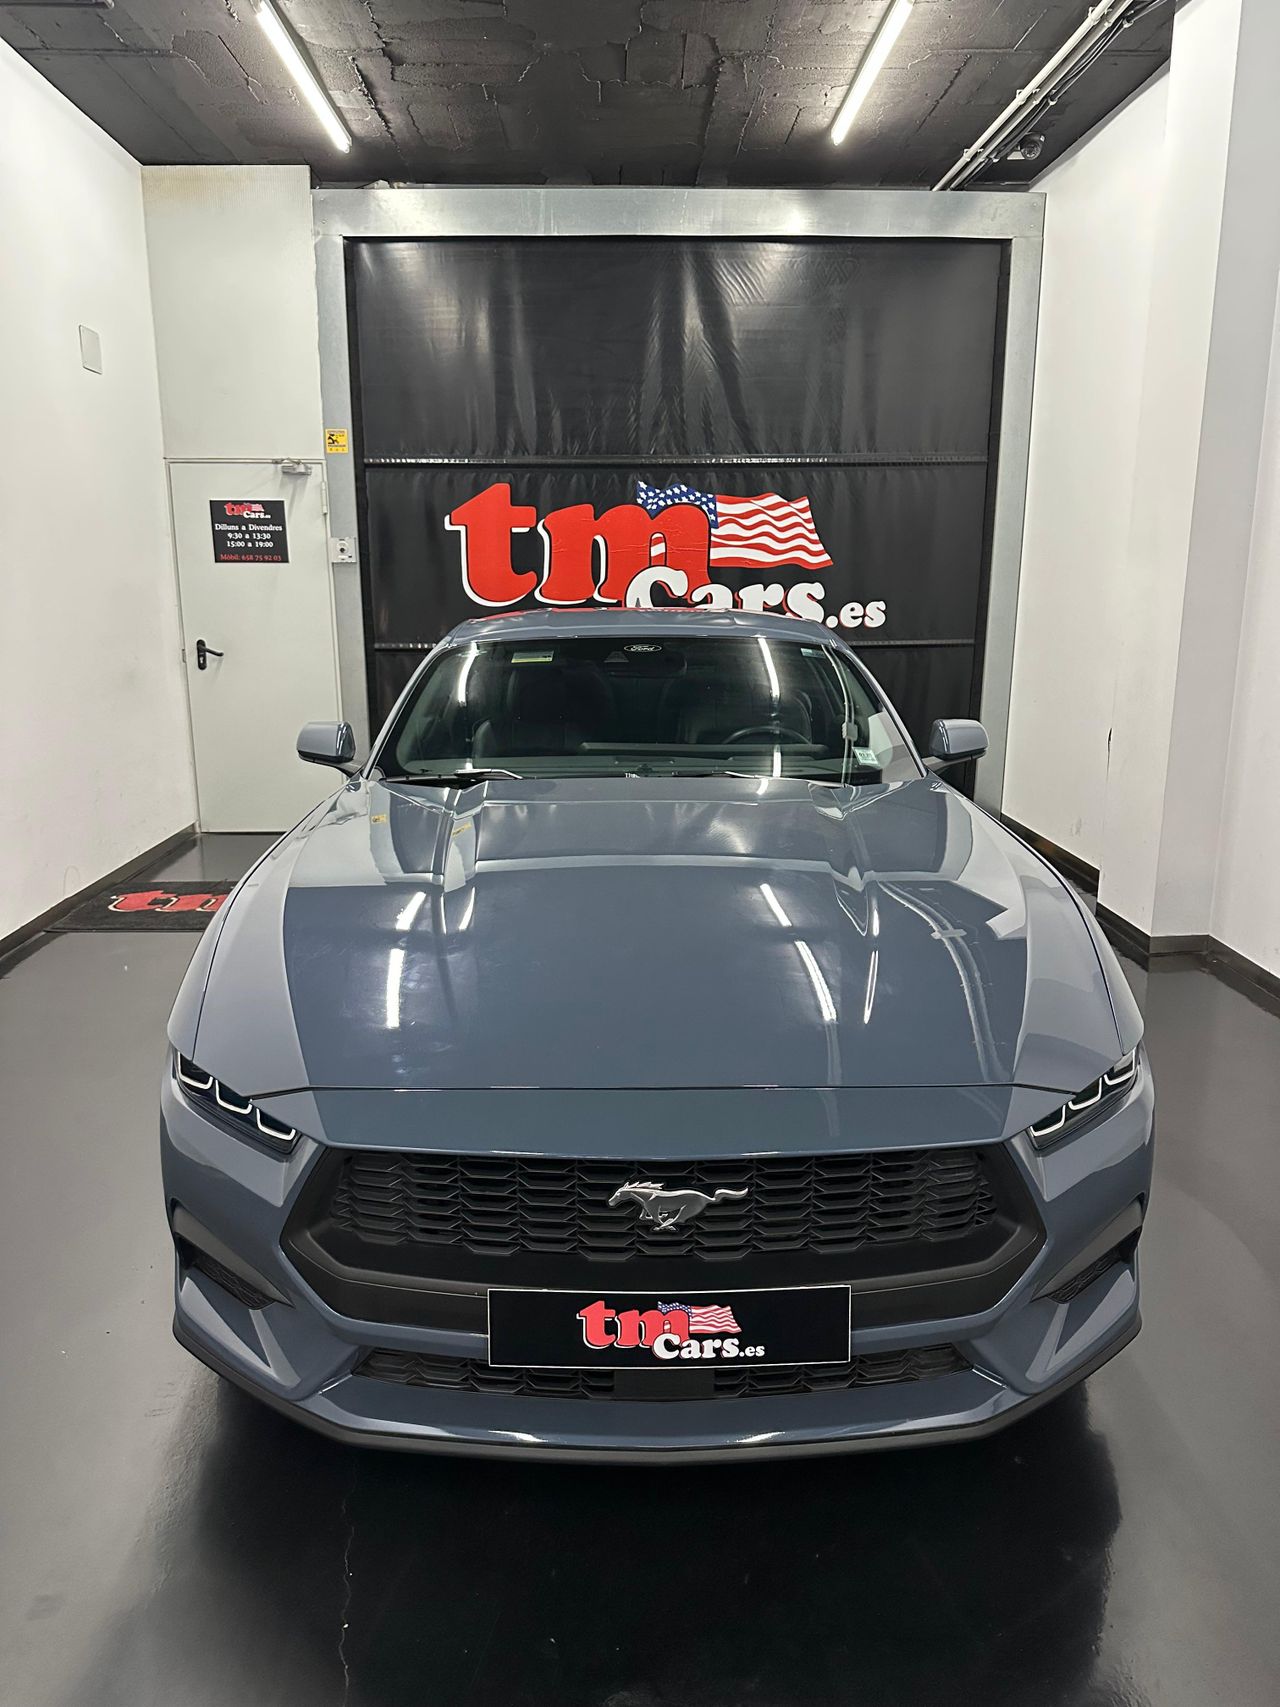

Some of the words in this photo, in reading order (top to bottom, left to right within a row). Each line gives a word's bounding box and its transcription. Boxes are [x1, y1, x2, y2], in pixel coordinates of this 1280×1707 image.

[215, 523, 239, 531] Dilluns
[248, 523, 283, 531] Divendres
[227, 532, 243, 540] 9:30
[252, 532, 271, 540] 13:30
[226, 540, 245, 548] 15:00
[444, 483, 712, 607] tm
[626, 566, 887, 628] Cars.es
[576, 1300, 692, 1349] tm
[652, 1333, 766, 1360] Cars.es
